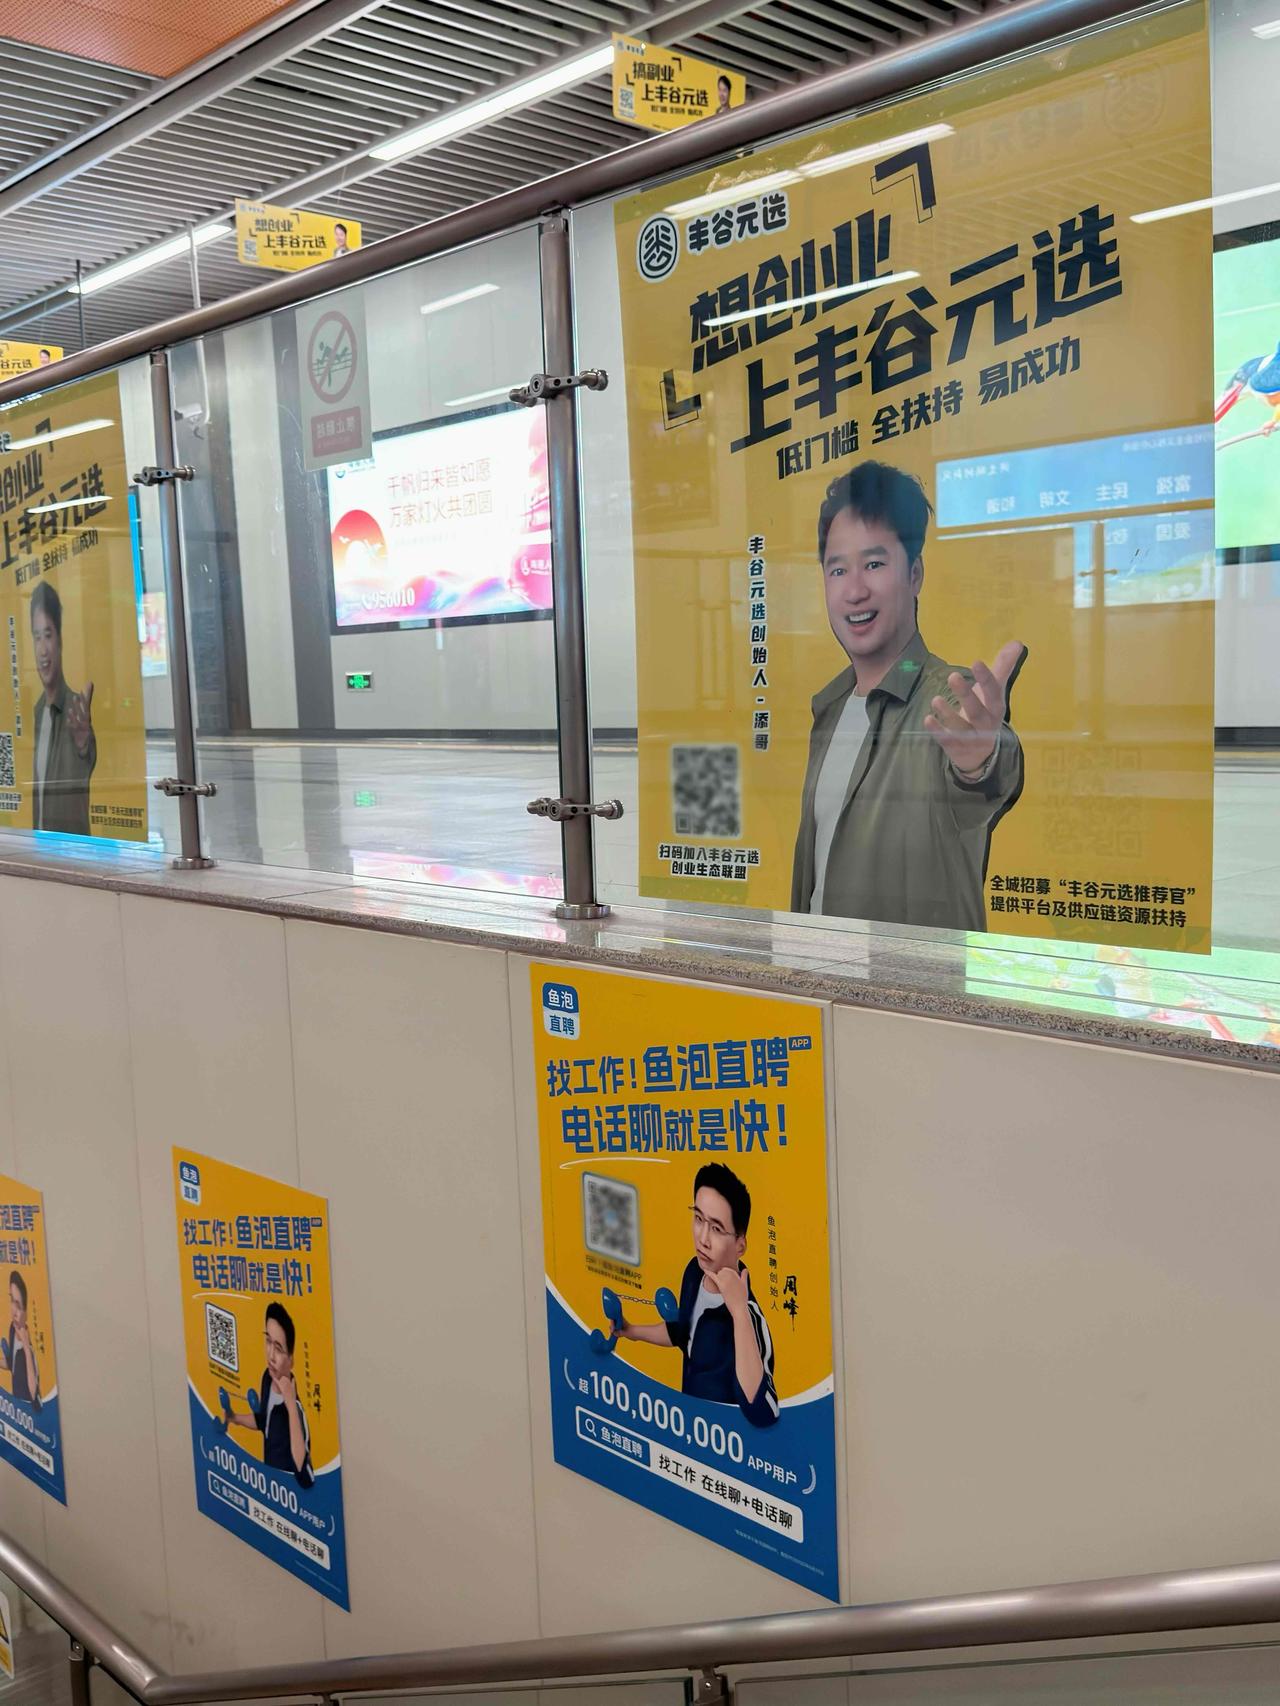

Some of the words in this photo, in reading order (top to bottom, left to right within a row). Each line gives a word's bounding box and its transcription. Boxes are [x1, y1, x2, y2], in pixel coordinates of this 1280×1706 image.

[633, 61, 675, 83] 搞副业
[641, 83, 708, 107] 上丰谷元选
[264, 234, 326, 249] 上丰谷元选
[689, 193, 787, 251] 丰谷元选
[690, 209, 893, 374] 想创业
[731, 204, 1123, 453] 上丰谷元选
[777, 419, 859, 480] 低门槛
[872, 380, 964, 445] 全扶持
[978, 335, 1081, 406] 易成功
[0, 449, 44, 514] 创业
[1, 463, 107, 569] 上丰谷元选
[389, 489, 493, 528] 万家灯火共团圆
[749, 536, 769, 751] 丰谷元选创始人-添哥
[660, 844, 759, 865] 扫码加入丰谷元选
[672, 861, 747, 880] 创业生态联盟
[990, 895, 1187, 928] 提供平台及供应链资源扶持
[548, 988, 574, 1010] 鱼泡
[550, 1014, 575, 1036] 直聘
[792, 1038, 809, 1048] APP
[561, 1099, 788, 1154] 电话聊就是快!
[192, 1253, 313, 1297] 电话聊就是快!
[601, 1426, 643, 1458] 鱼泡直聘
[658, 1453, 697, 1484] 找工作
[700, 1473, 794, 1530] 在线聊+电话聊
